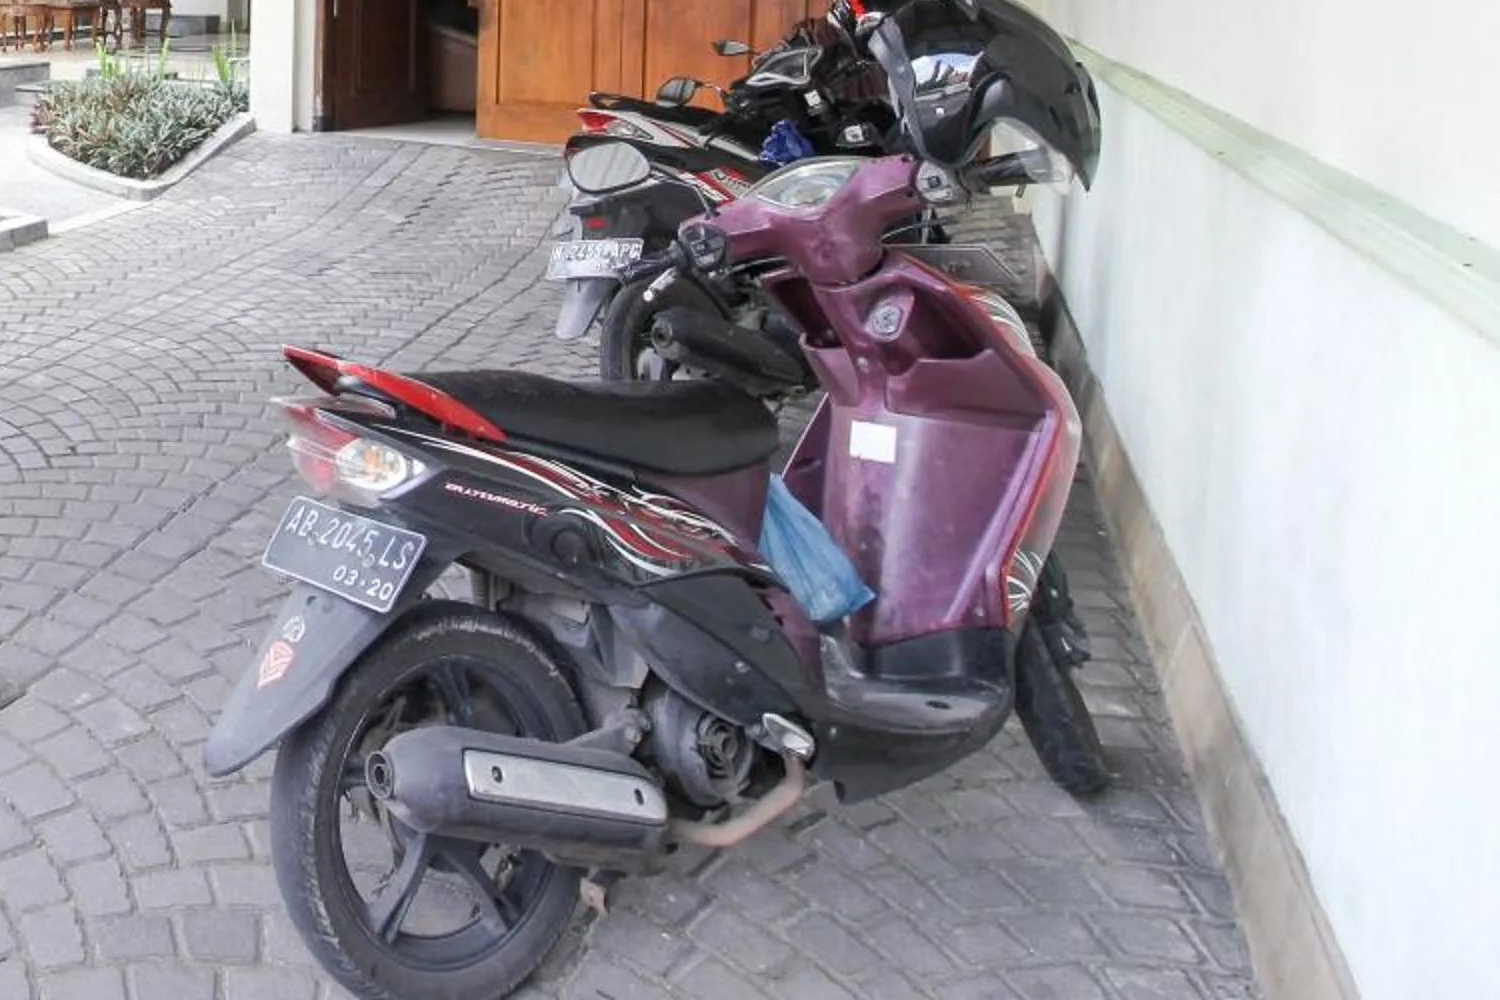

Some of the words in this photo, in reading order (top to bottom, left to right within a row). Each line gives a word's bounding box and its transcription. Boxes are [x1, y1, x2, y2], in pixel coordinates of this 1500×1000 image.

[284, 505, 319, 537] AB
[318, 517, 379, 557] 2045
[379, 535, 415, 570] LS
